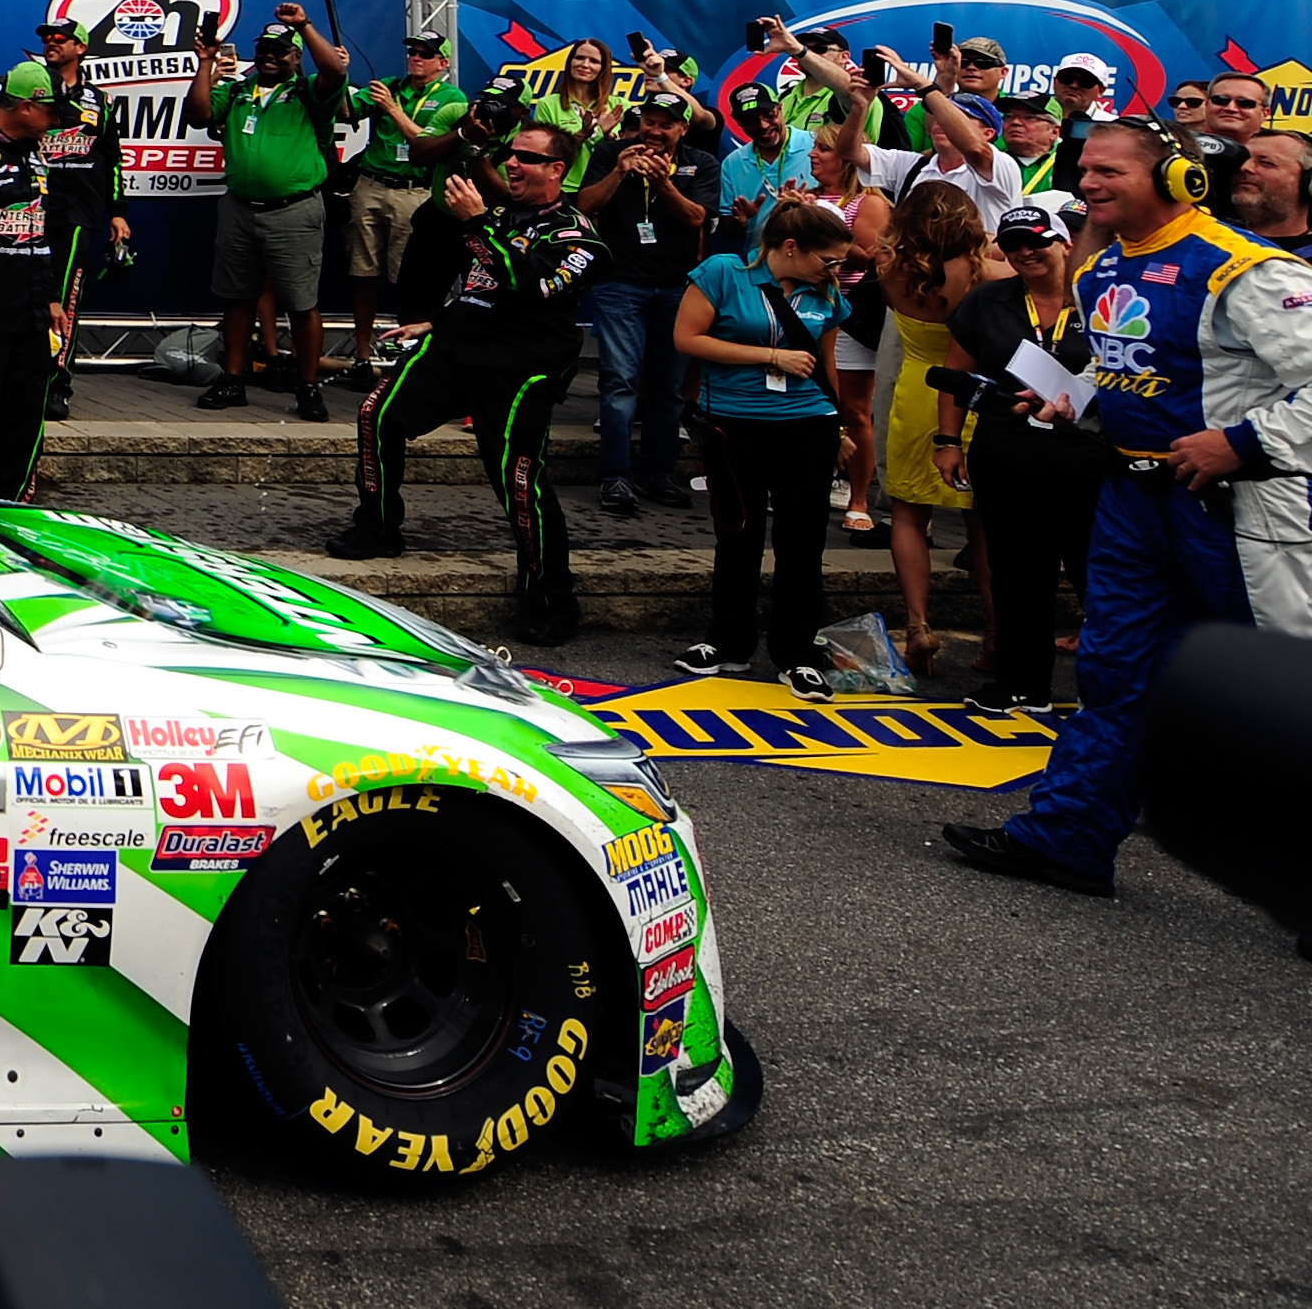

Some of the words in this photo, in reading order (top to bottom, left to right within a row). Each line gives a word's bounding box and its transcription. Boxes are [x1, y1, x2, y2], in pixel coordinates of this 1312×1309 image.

[149, 174, 193, 192] 1990
[1090, 336, 1156, 373] NBC
[12, 744, 83, 760] MECHANIX
[82, 748, 124, 761] WEAR
[129, 719, 216, 756] Holley
[215, 725, 263, 754] EFI
[15, 766, 105, 798] Mobil
[115, 769, 139, 797] 1
[307, 745, 538, 804] GOODYEAR
[158, 763, 257, 819] 3M
[49, 828, 145, 848] freescale
[165, 829, 265, 854] Duralast
[605, 822, 674, 876] MOOG
[48, 862, 109, 876] SHERWIN
[189, 859, 239, 870] BRAKES
[47, 876, 110, 892] WILLIAMS
[627, 859, 688, 916] MAHLE
[645, 911, 685, 954] COMP
